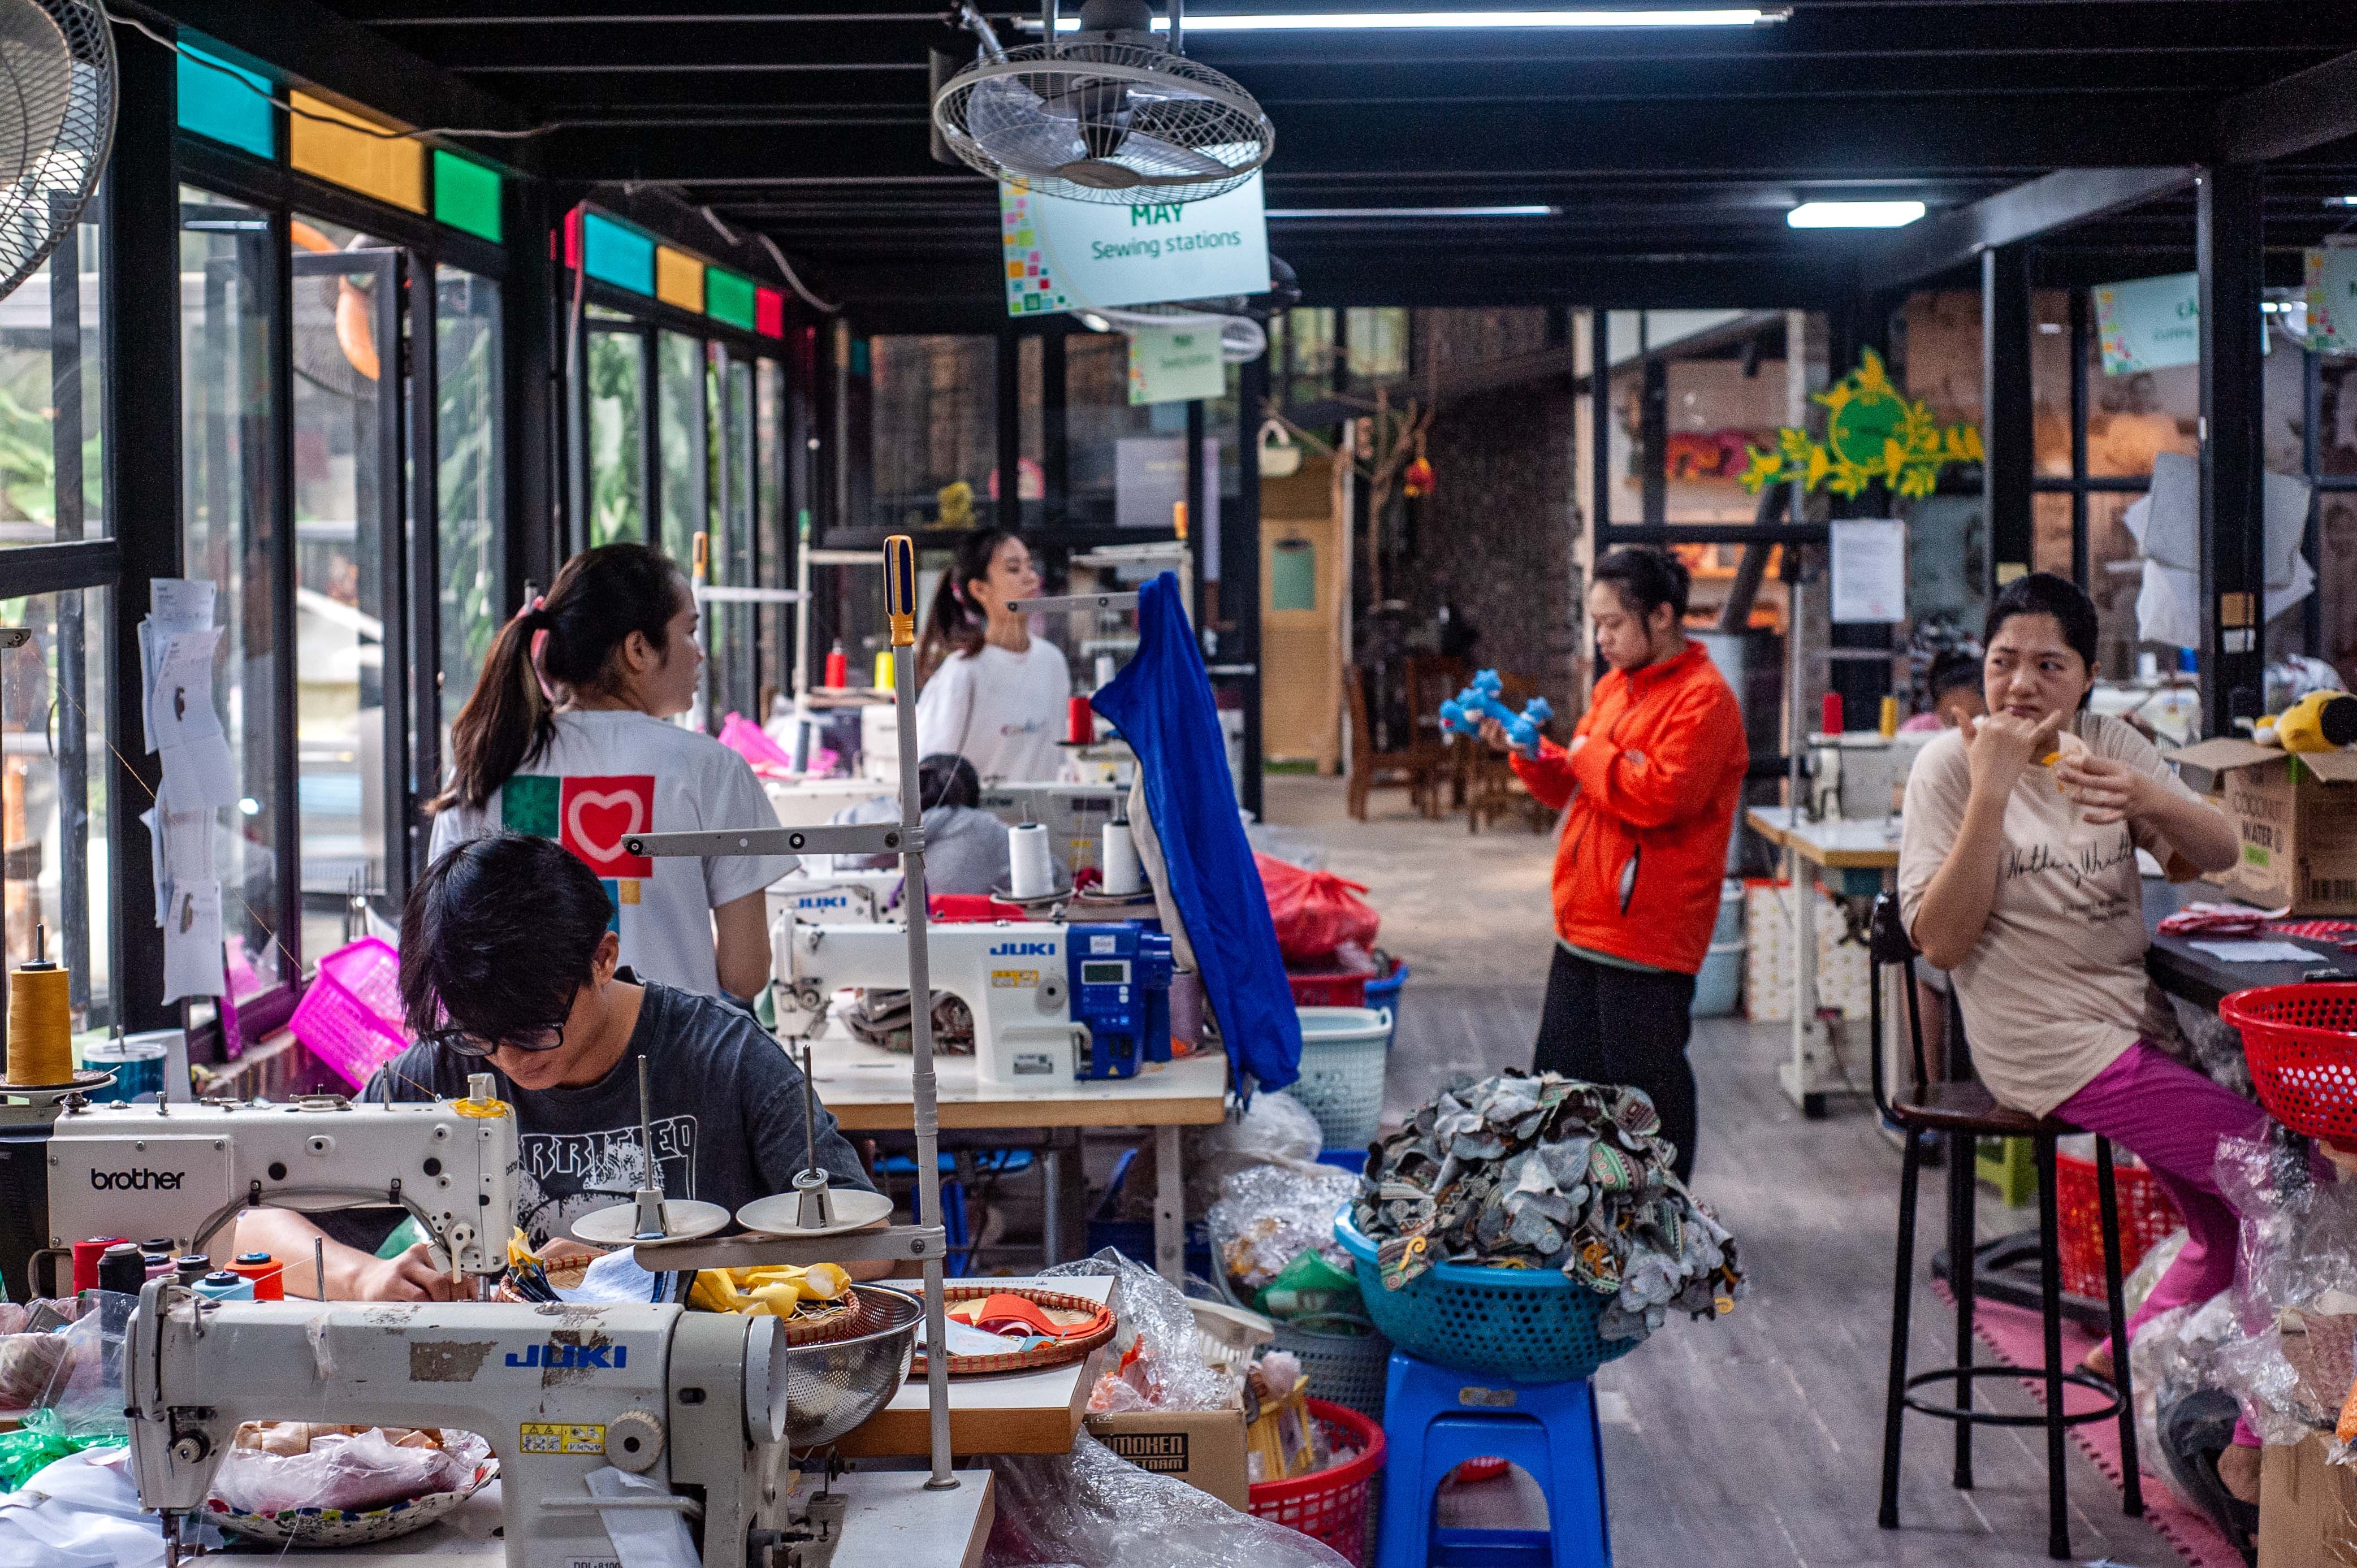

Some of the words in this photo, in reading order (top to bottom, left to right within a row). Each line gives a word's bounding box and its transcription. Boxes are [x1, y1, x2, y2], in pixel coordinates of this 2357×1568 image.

[1131, 203, 1185, 226] MAY
[1091, 239, 1161, 261] Sewing
[1166, 229, 1242, 253] stations
[991, 943, 1056, 955] JUKI
[90, 1168, 185, 1190] brother
[505, 1345, 626, 1368] JUKI
